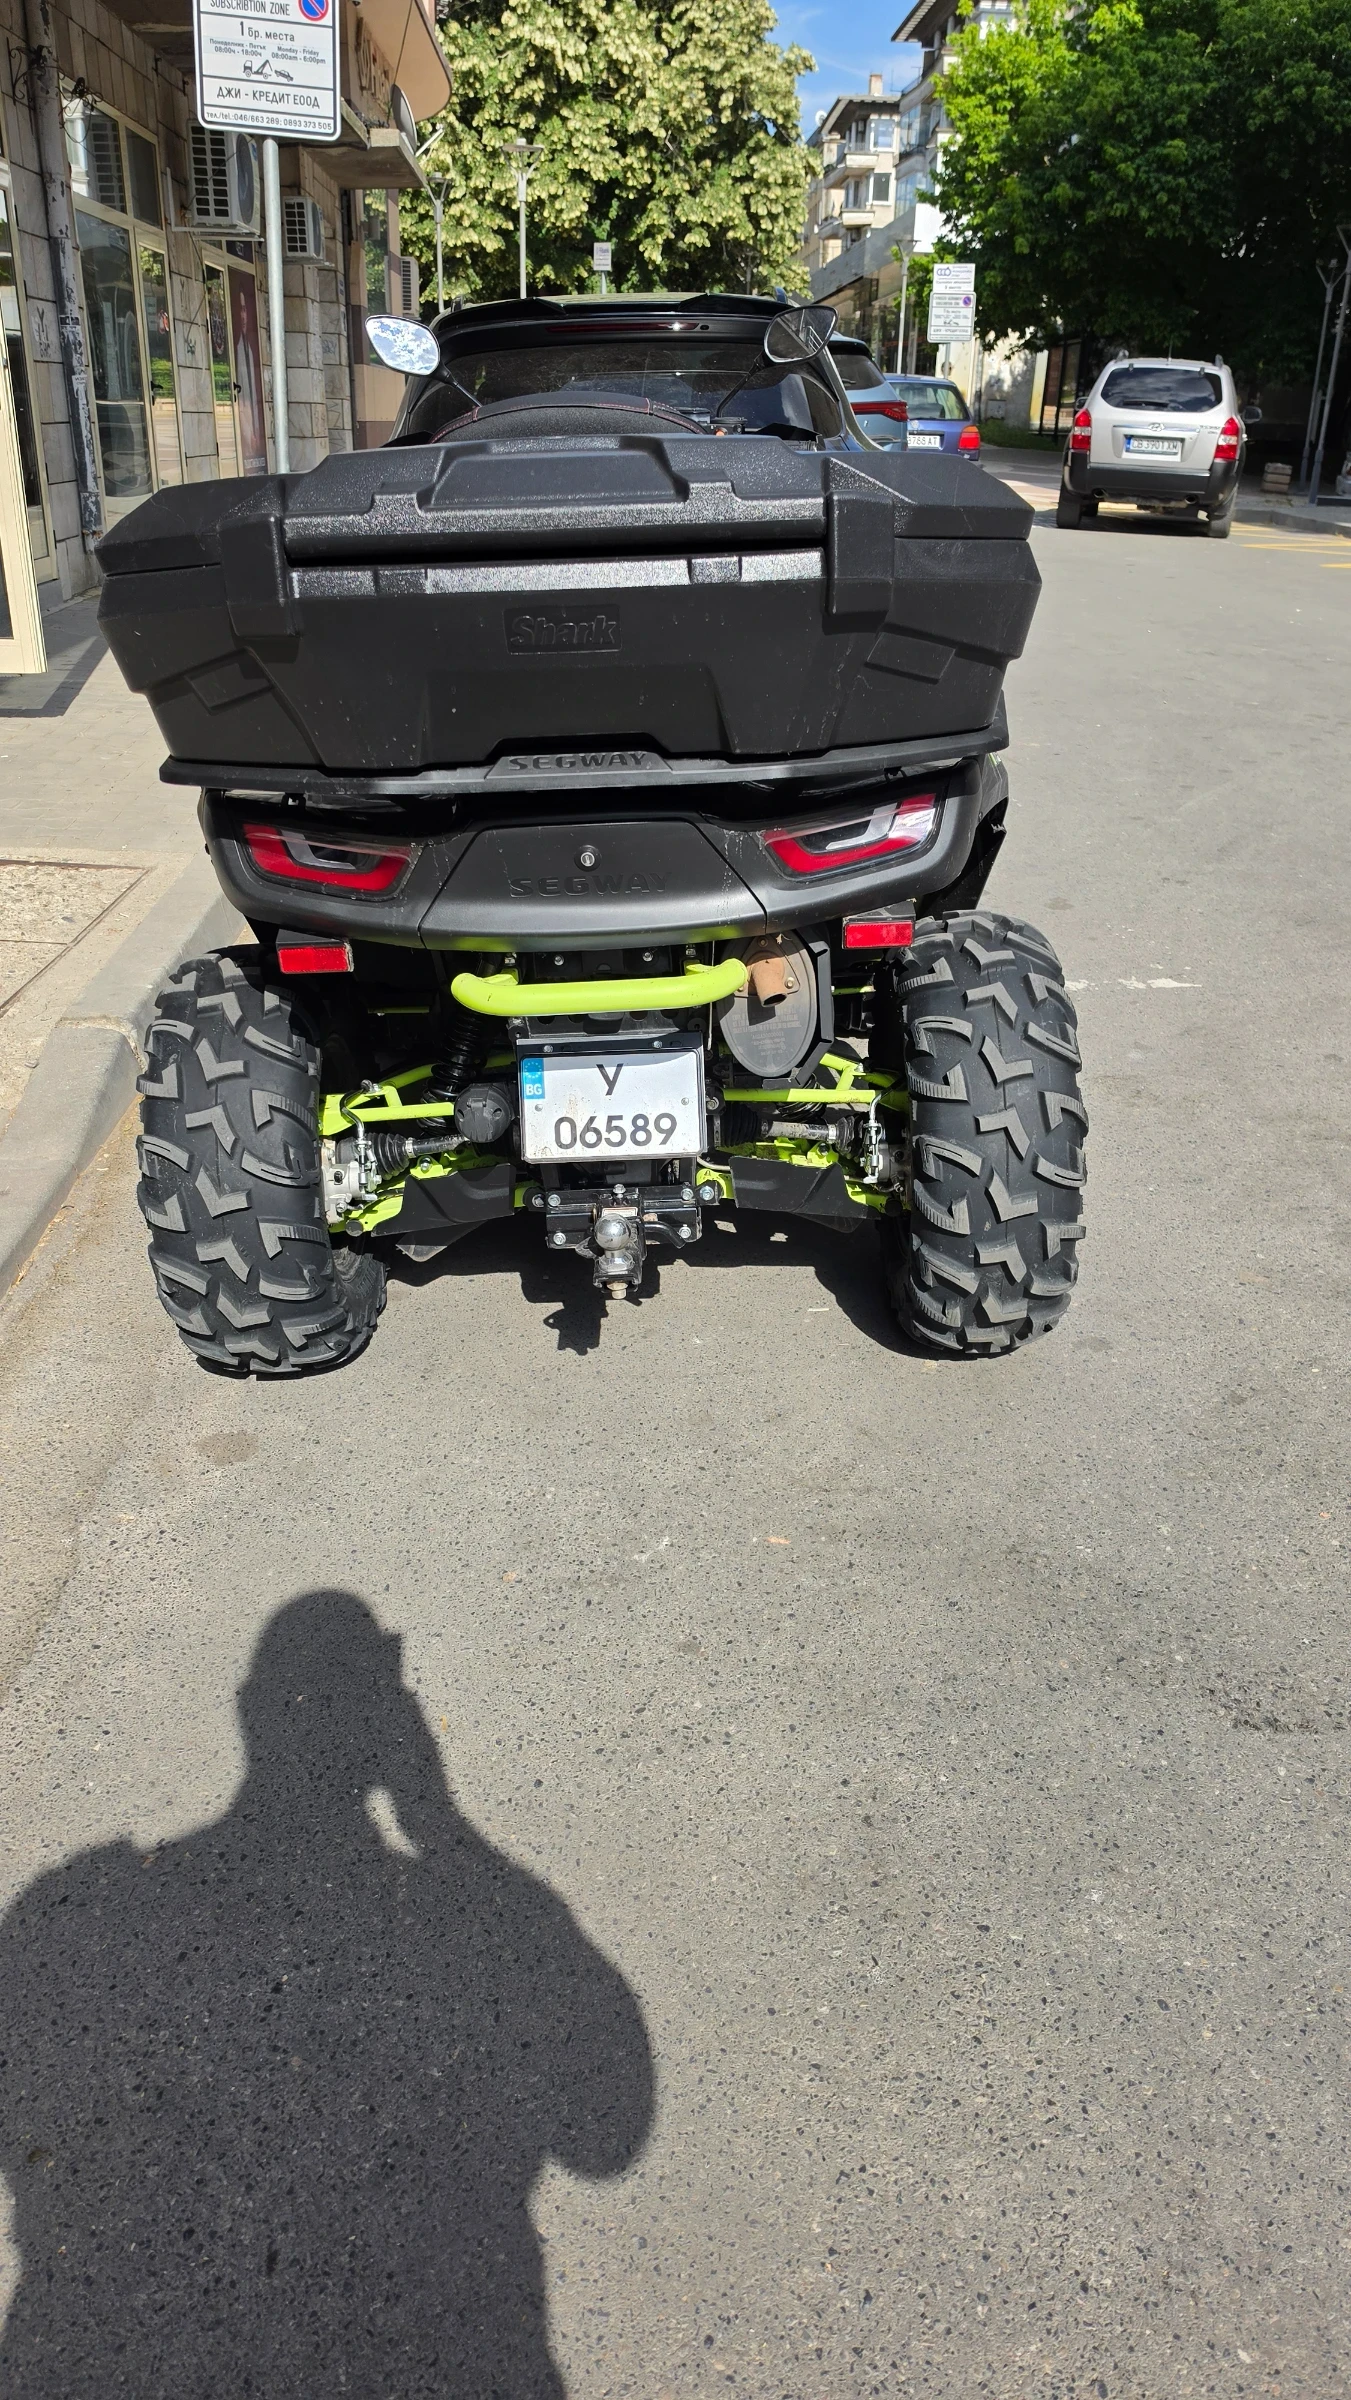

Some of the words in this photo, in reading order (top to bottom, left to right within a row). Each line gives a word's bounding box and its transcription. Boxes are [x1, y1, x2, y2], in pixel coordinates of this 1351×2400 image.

[210, 0, 266, 13] SUBSCRIBTION
[270, 2, 290, 16] ZONE
[240, 21, 245, 36] 1
[248, 27, 262, 40] бр.
[265, 31, 295, 42] места
[209, 38, 244, 48] Понеделник
[214, 46, 235, 54] 08:00ч
[242, 48, 262, 57] 18:00ч
[271, 52, 298, 61] 08:00am
[303, 56, 326, 65] 6:00pm
[277, 46, 298, 55] Monday
[303, 49, 319, 57] Friday
[217, 86, 241, 99] ДЖИ
[252, 90, 291, 105] КРЕДИТ
[293, 94, 320, 109] ЕООД
[283, 119, 302, 128] 0893
[318, 122, 332, 130] 505
[510, 615, 617, 646] Shark
[508, 751, 647, 770] SEGWAY
[510, 871, 673, 898] SEGWAY
[525, 1083, 543, 1096] BG
[554, 1112, 678, 1150] 06589
